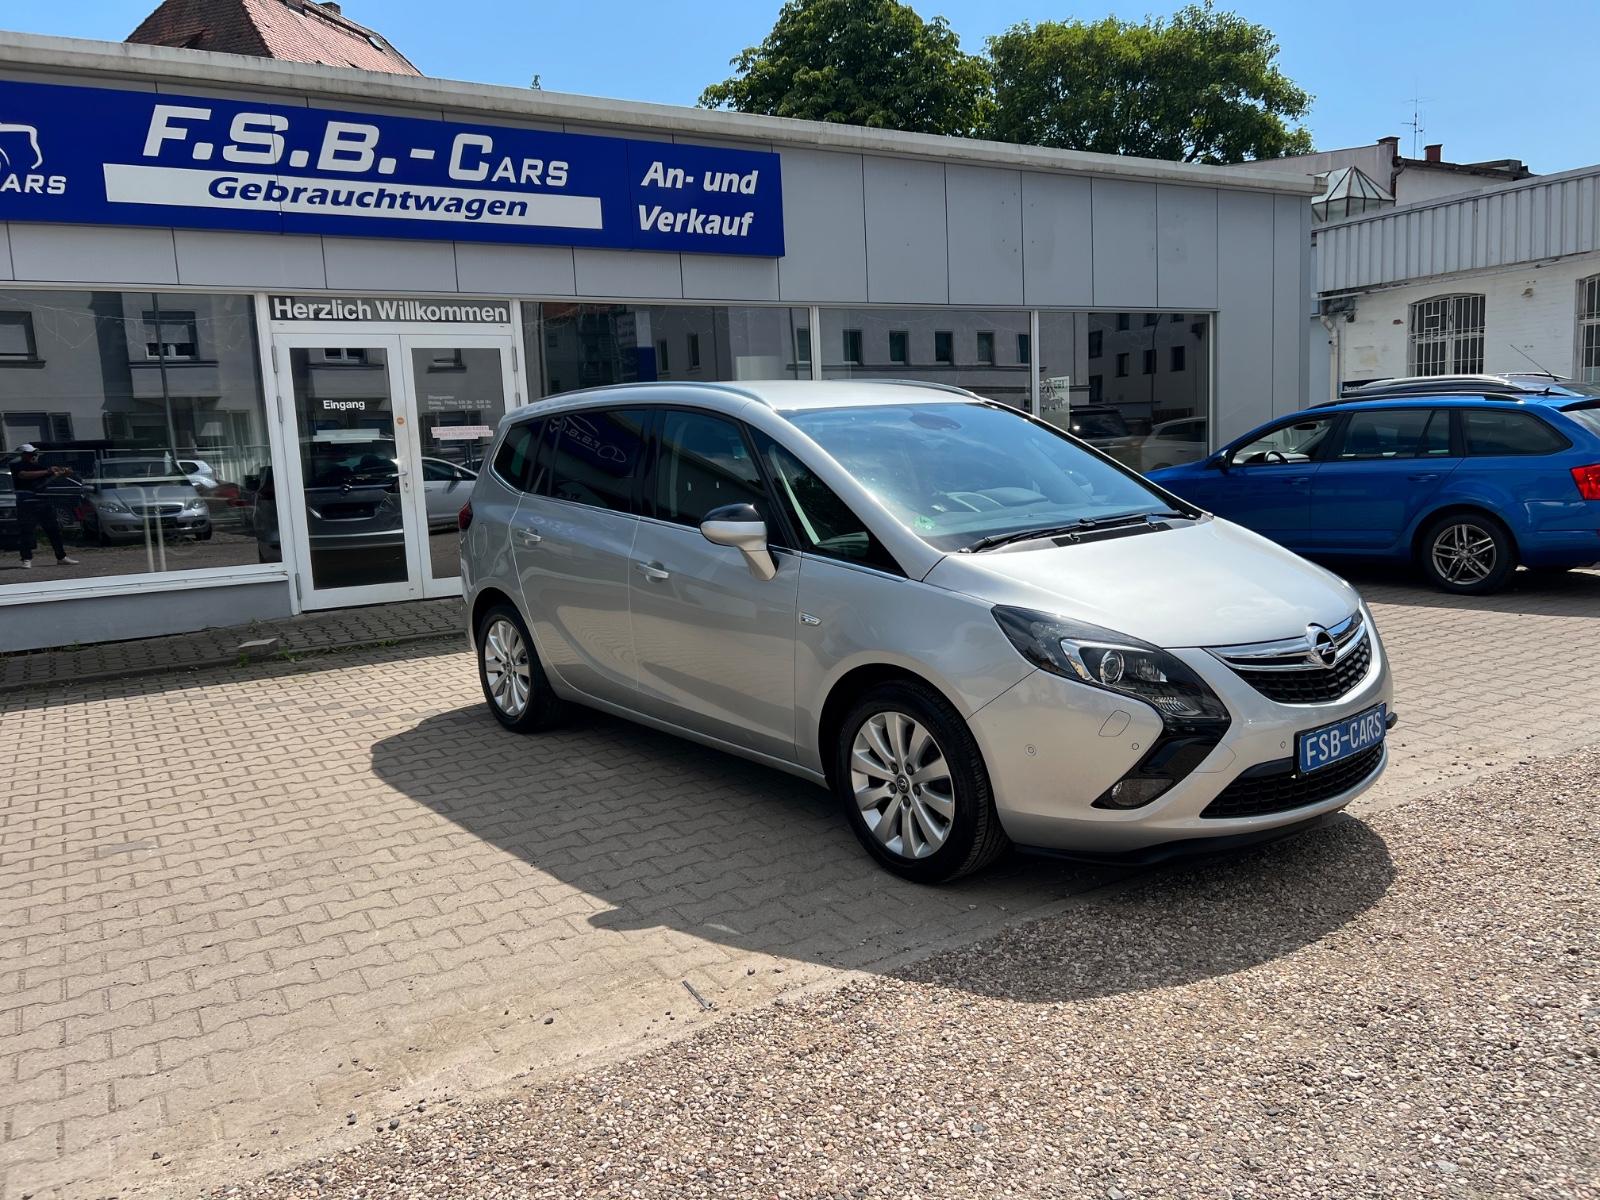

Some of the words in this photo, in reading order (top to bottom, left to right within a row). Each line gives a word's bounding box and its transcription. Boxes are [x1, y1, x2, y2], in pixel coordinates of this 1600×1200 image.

[641, 162, 694, 189] An-
[703, 170, 758, 195] und
[209, 176, 527, 219] Gebrauchtwagen
[638, 205, 753, 237] Verkauf
[274, 298, 372, 320] Herzlich
[375, 300, 507, 322] Willkommen
[323, 400, 366, 411] Eingang
[1306, 712, 1382, 766] FSB-CARS
